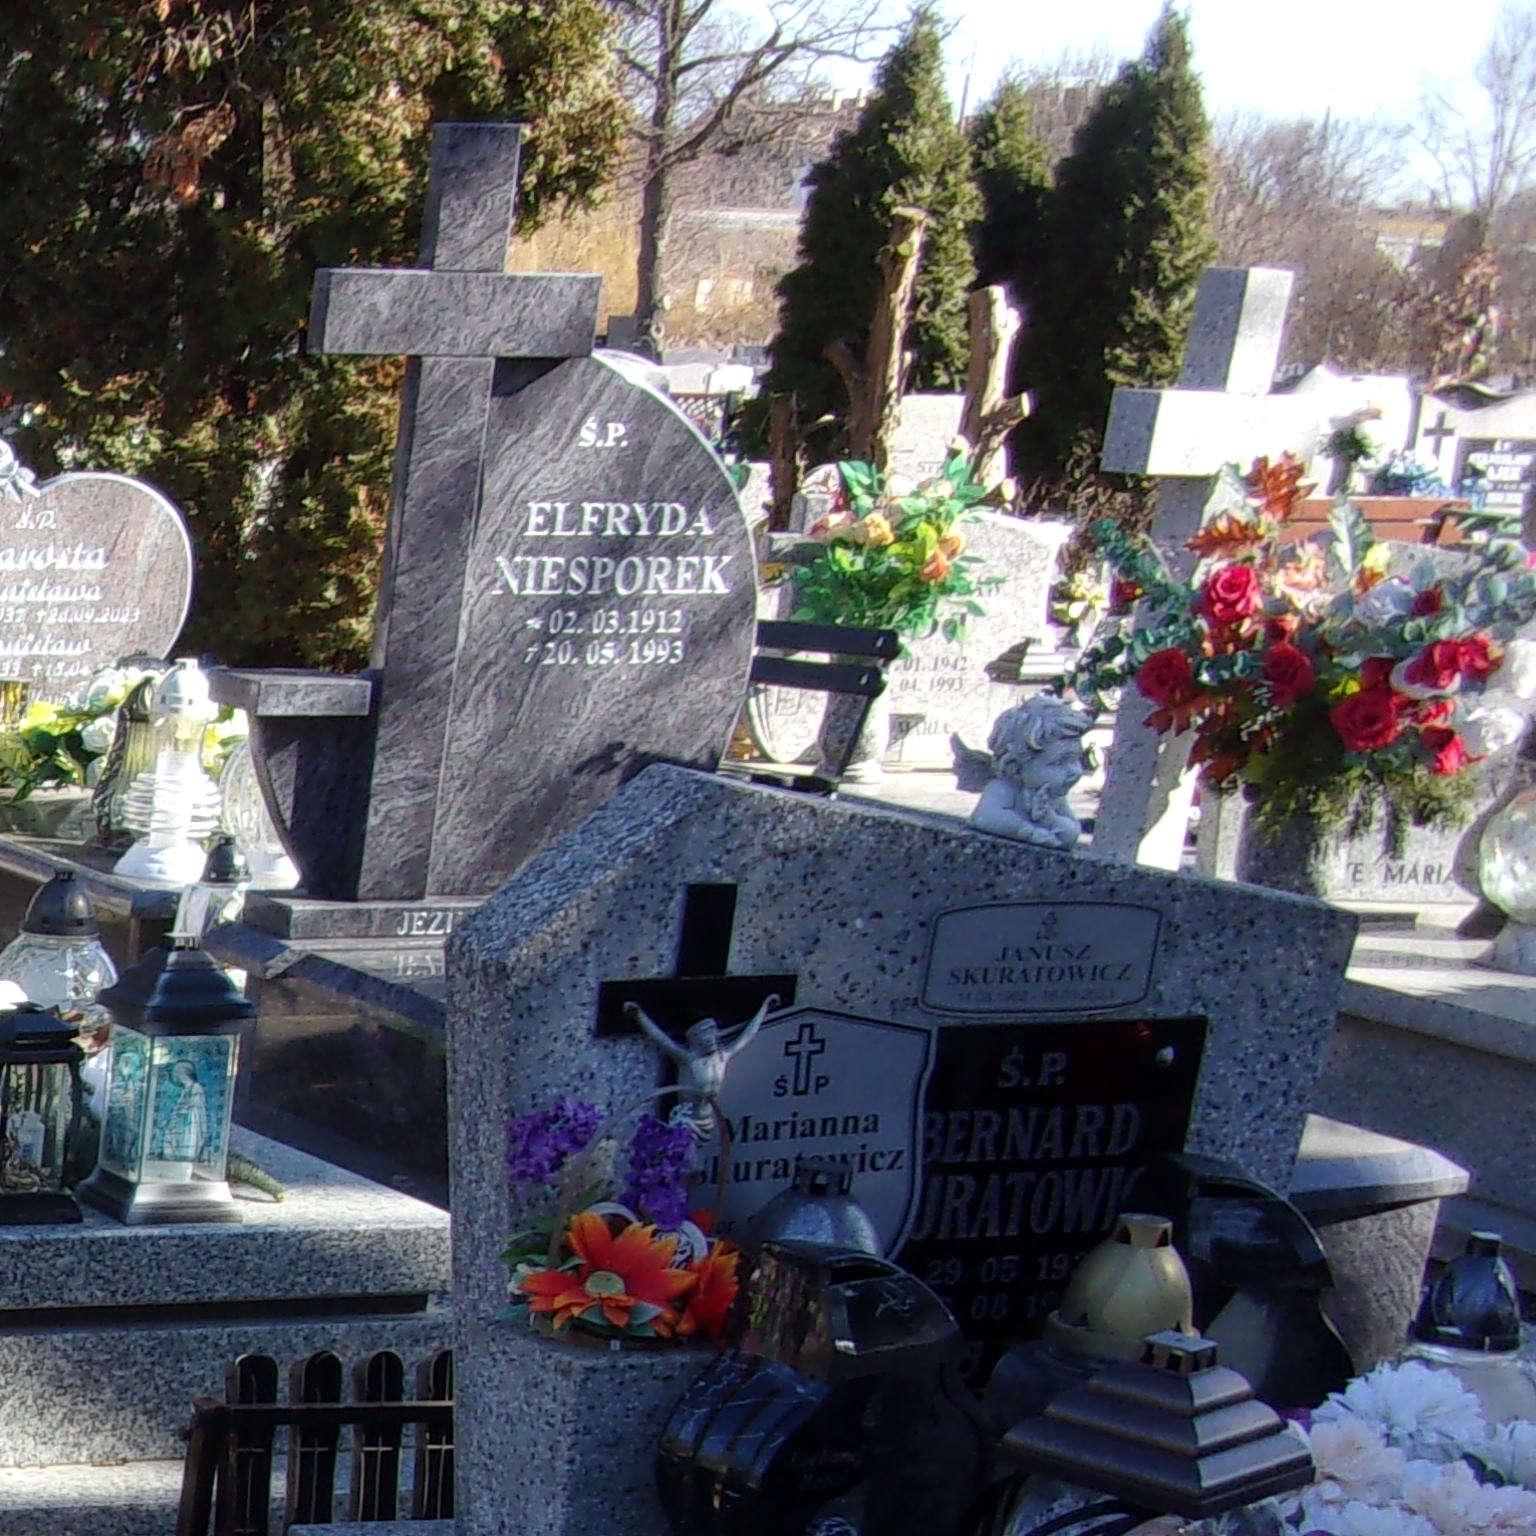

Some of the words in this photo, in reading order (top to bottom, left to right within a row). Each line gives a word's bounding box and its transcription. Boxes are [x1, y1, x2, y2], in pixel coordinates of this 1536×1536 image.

[523, 502, 716, 537] ELFRYDA
[491, 555, 734, 597] NIESPOREK
[995, 944, 1092, 962] JANUSZ
[946, 963, 1133, 986] SKURATOWICZ
[724, 1111, 880, 1144] Marianna
[923, 1101, 1142, 1164] BERNARD
